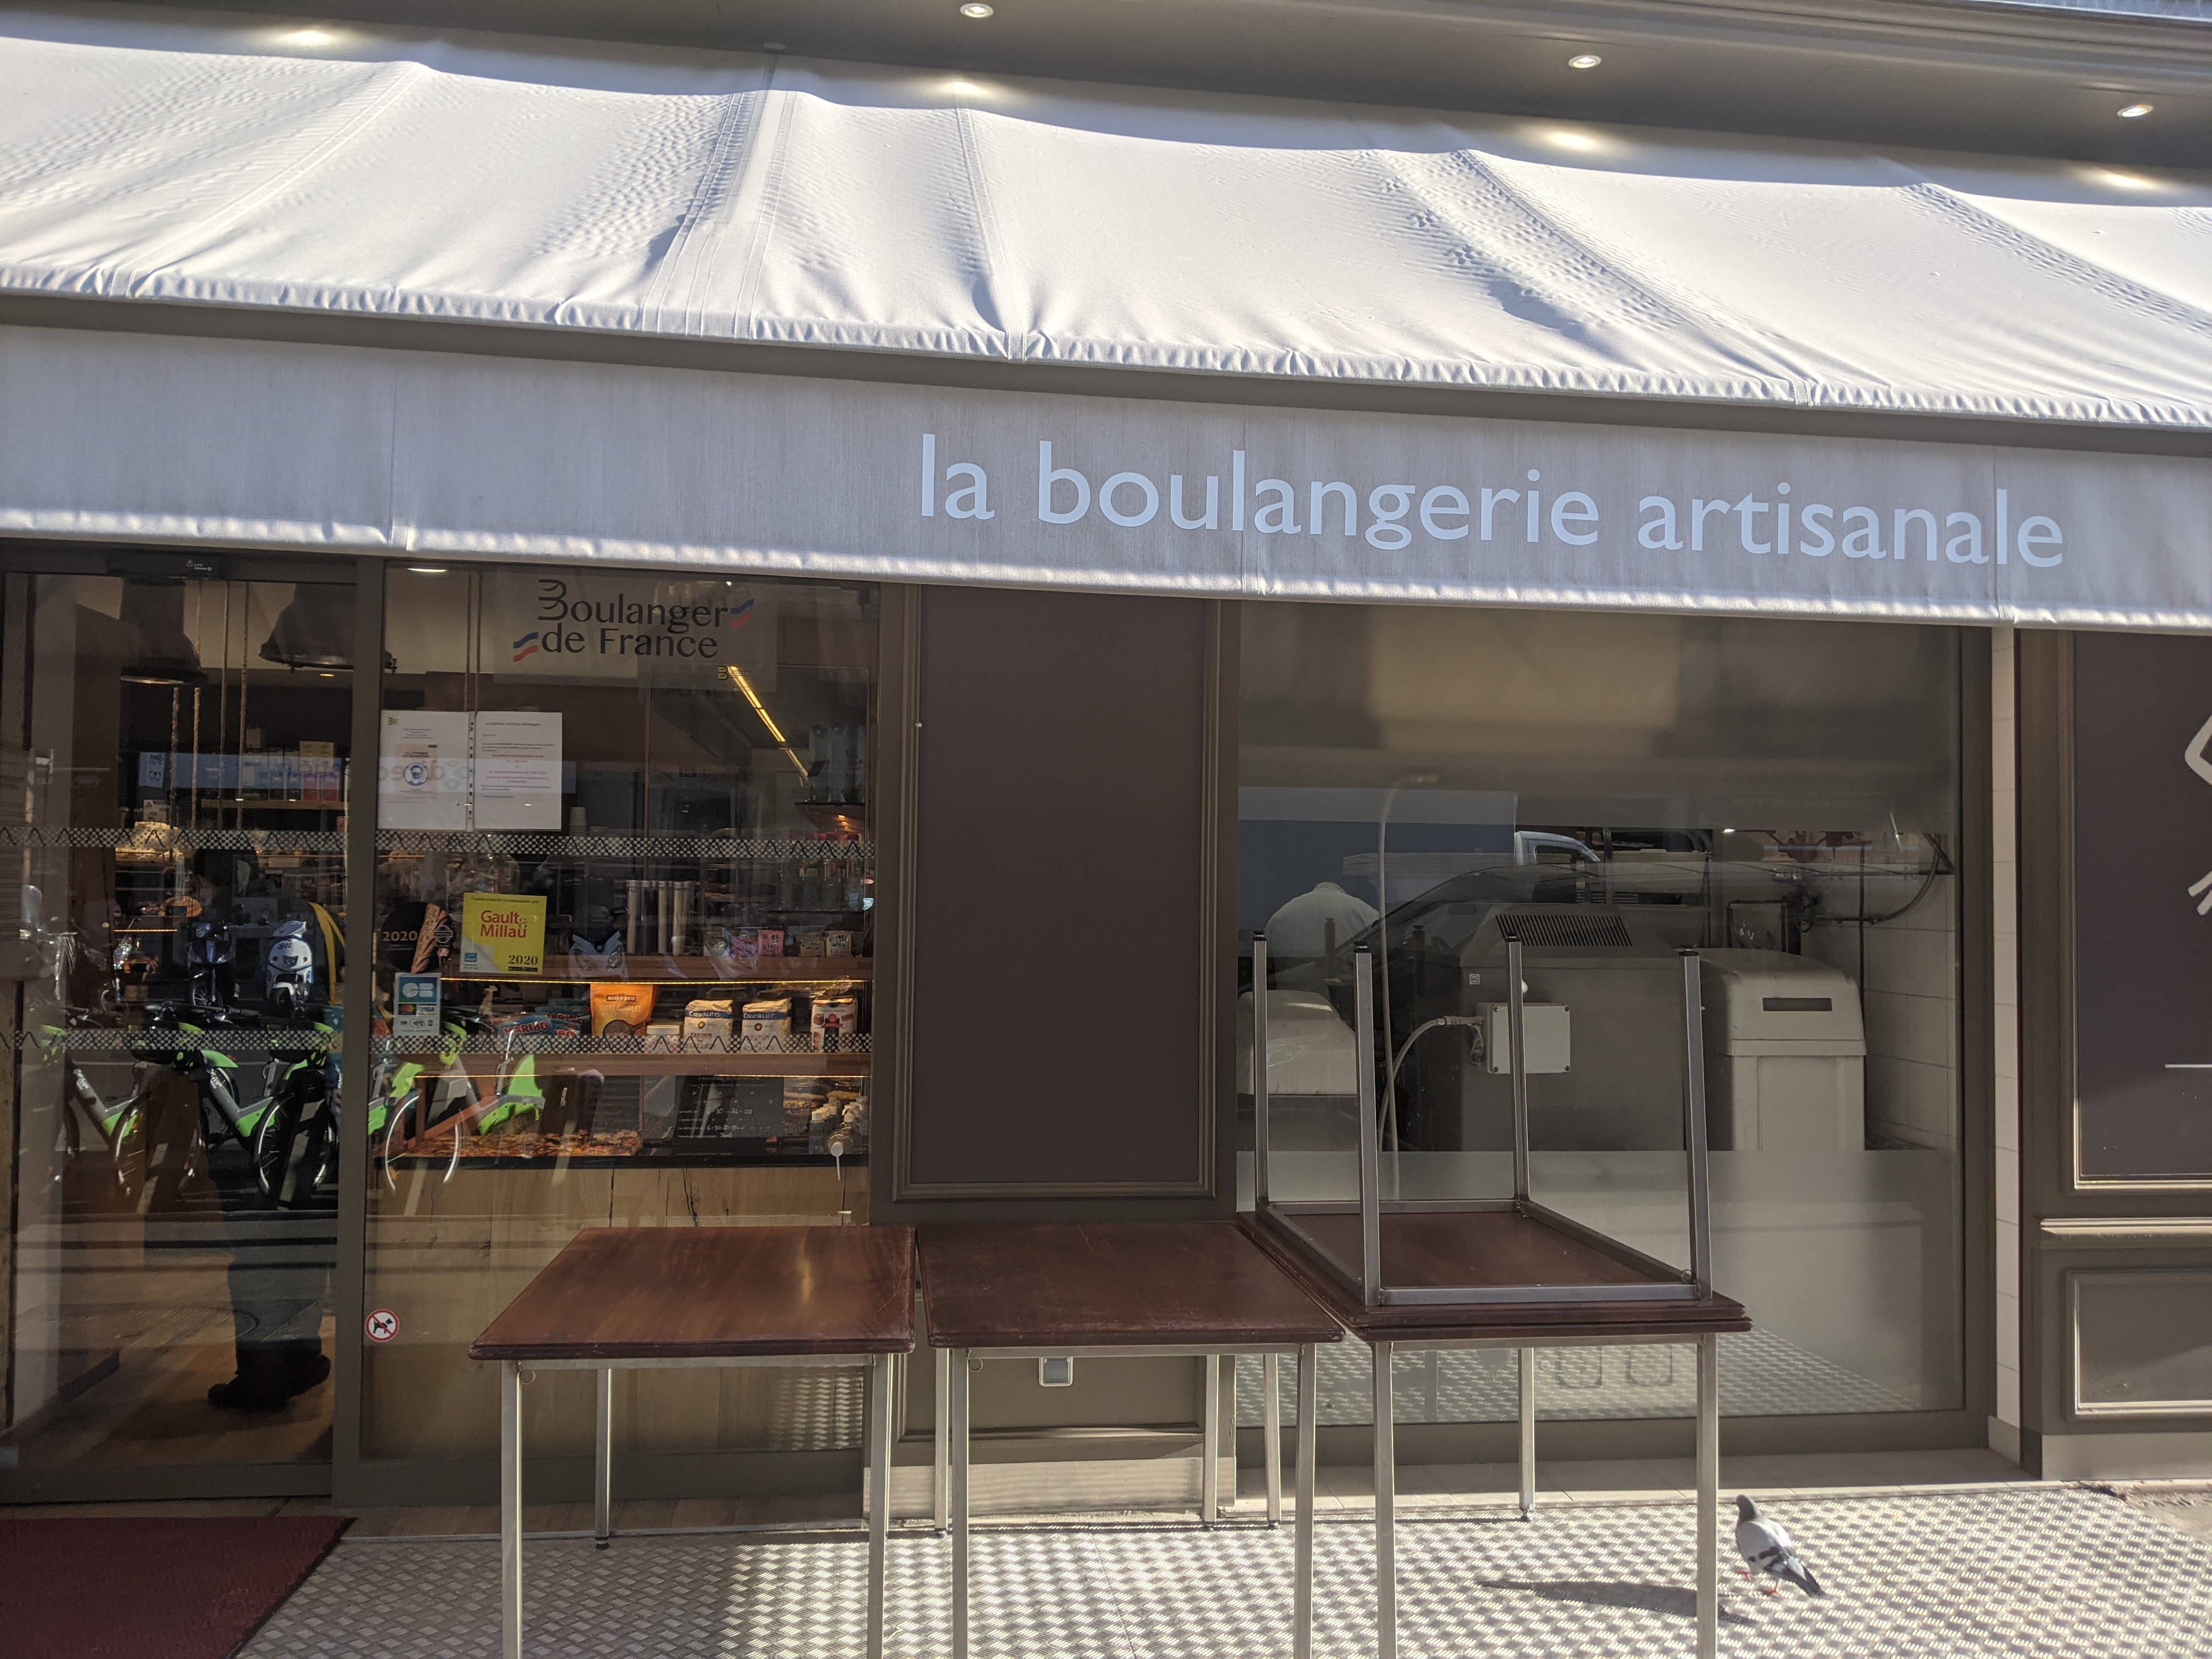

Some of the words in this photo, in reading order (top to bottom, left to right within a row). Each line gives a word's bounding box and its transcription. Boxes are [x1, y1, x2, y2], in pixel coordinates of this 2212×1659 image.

[921, 433, 995, 520] la
[1038, 441, 1599, 550] boulangerie
[1637, 482, 2063, 568] artisanale
[538, 579, 729, 634] Boulanger
[541, 622, 585, 653] de
[600, 628, 718, 658] France
[481, 910, 521, 924] Gault
[382, 931, 418, 942] 2020
[480, 923, 527, 938] Millau
[508, 955, 538, 966] 2020
[503, 1020, 549, 1036] HARIBO
